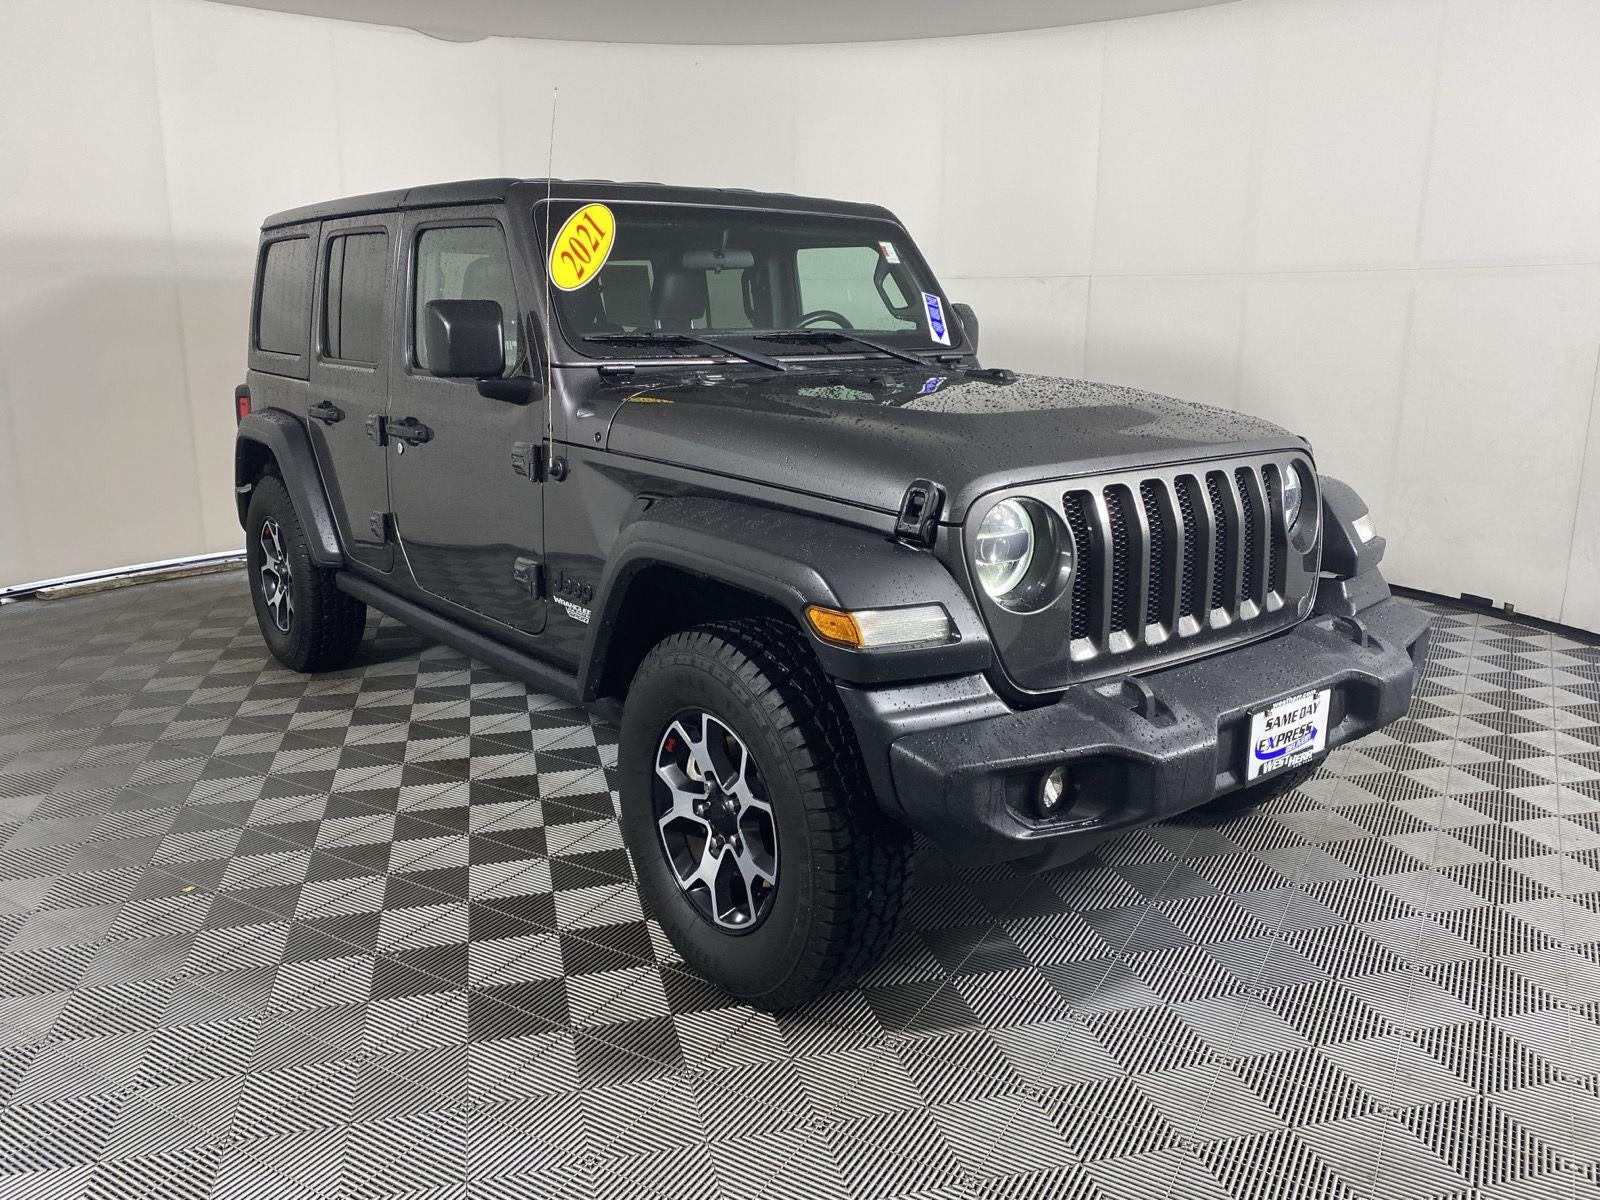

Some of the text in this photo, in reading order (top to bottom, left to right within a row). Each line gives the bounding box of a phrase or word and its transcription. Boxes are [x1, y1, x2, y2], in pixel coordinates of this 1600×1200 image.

[560, 211, 606, 280] 2021
[1265, 700, 1321, 731] SAME DAY
[1258, 721, 1314, 752] EXPRESS
